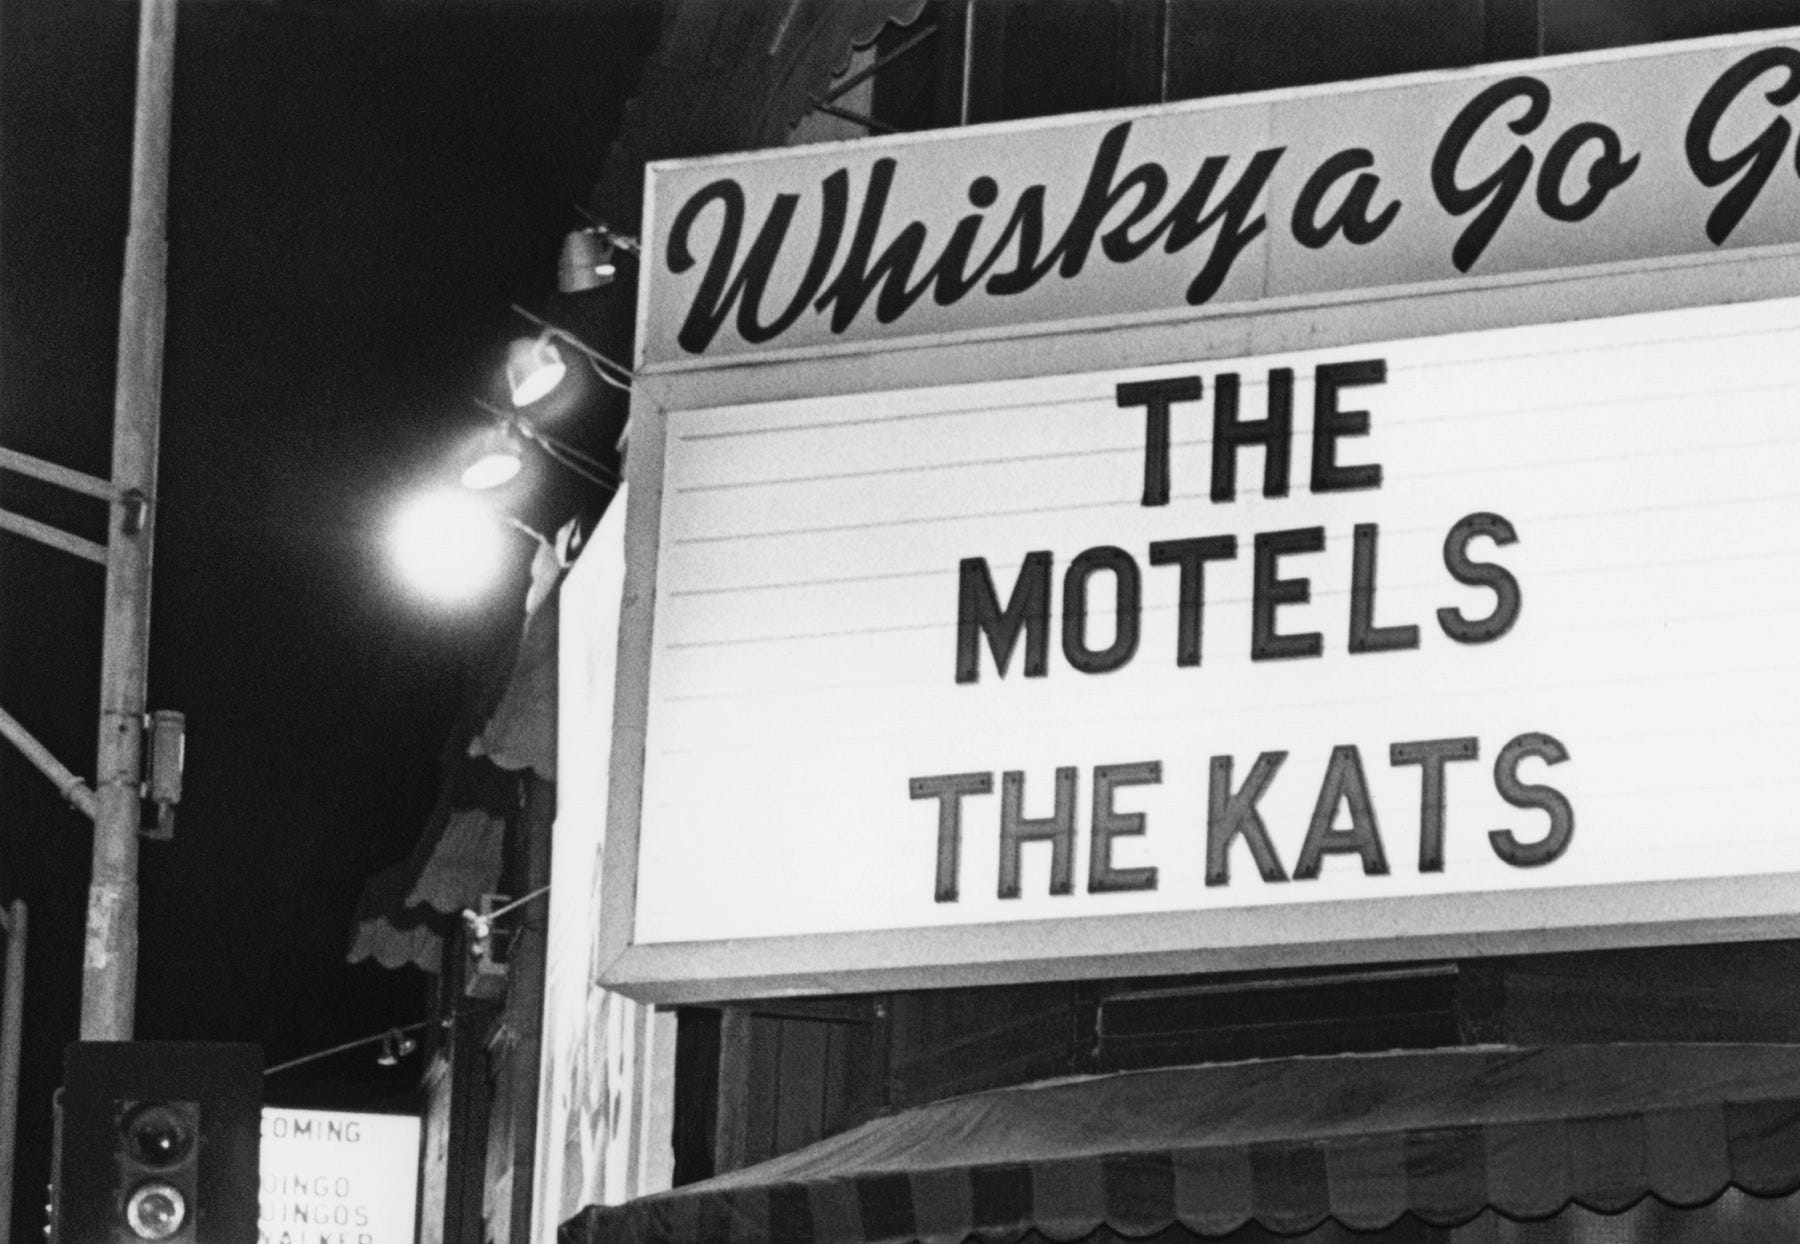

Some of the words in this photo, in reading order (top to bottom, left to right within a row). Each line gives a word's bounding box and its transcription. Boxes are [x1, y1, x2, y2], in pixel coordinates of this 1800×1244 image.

[665, 121, 1286, 356] Whisky
[1289, 147, 1403, 250] a
[1430, 76, 1641, 275] Go
[1114, 358, 1388, 508] THE
[953, 511, 1523, 686] MOTELS
[908, 760, 1164, 904] THE
[1204, 731, 1576, 888] KATS
[262, 1117, 361, 1143] OMING
